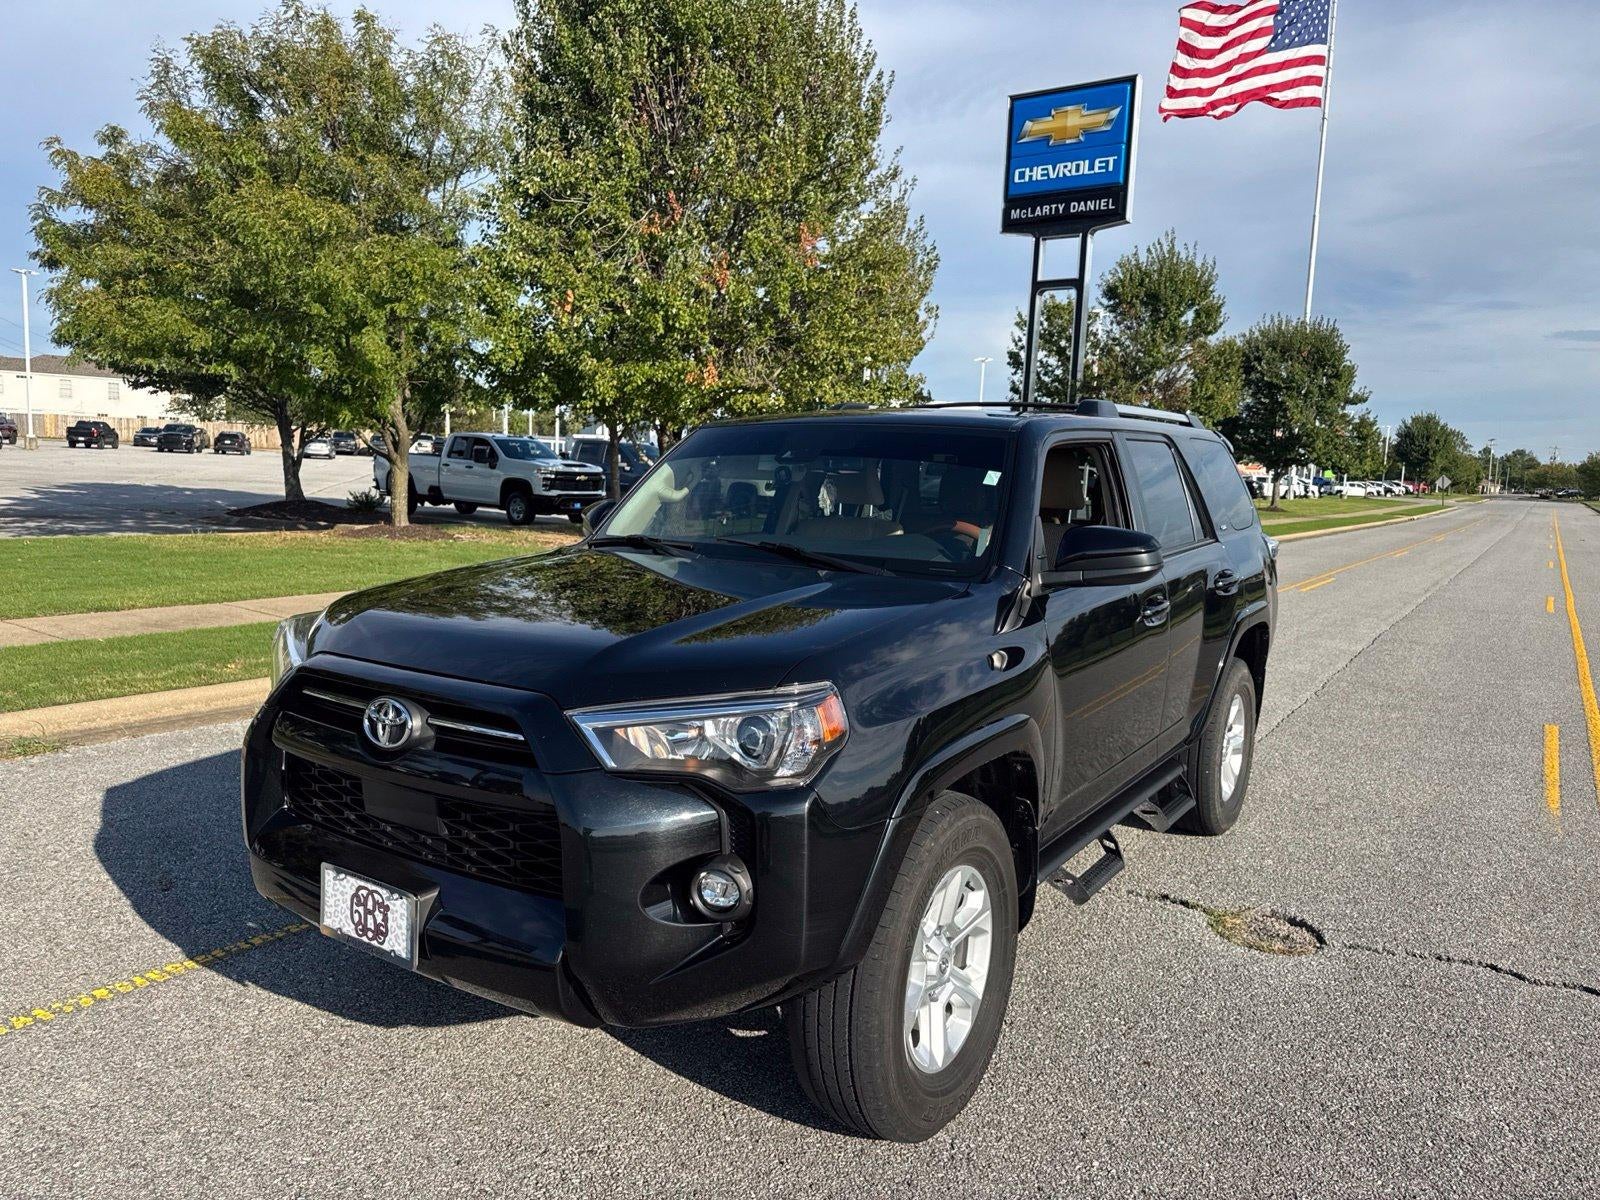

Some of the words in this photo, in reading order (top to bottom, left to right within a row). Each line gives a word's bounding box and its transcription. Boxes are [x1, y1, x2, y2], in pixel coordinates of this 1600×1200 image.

[1014, 156, 1117, 183] CHEVROLET
[1010, 203, 1065, 219] McLARTY
[1070, 198, 1116, 213] DANIEL
